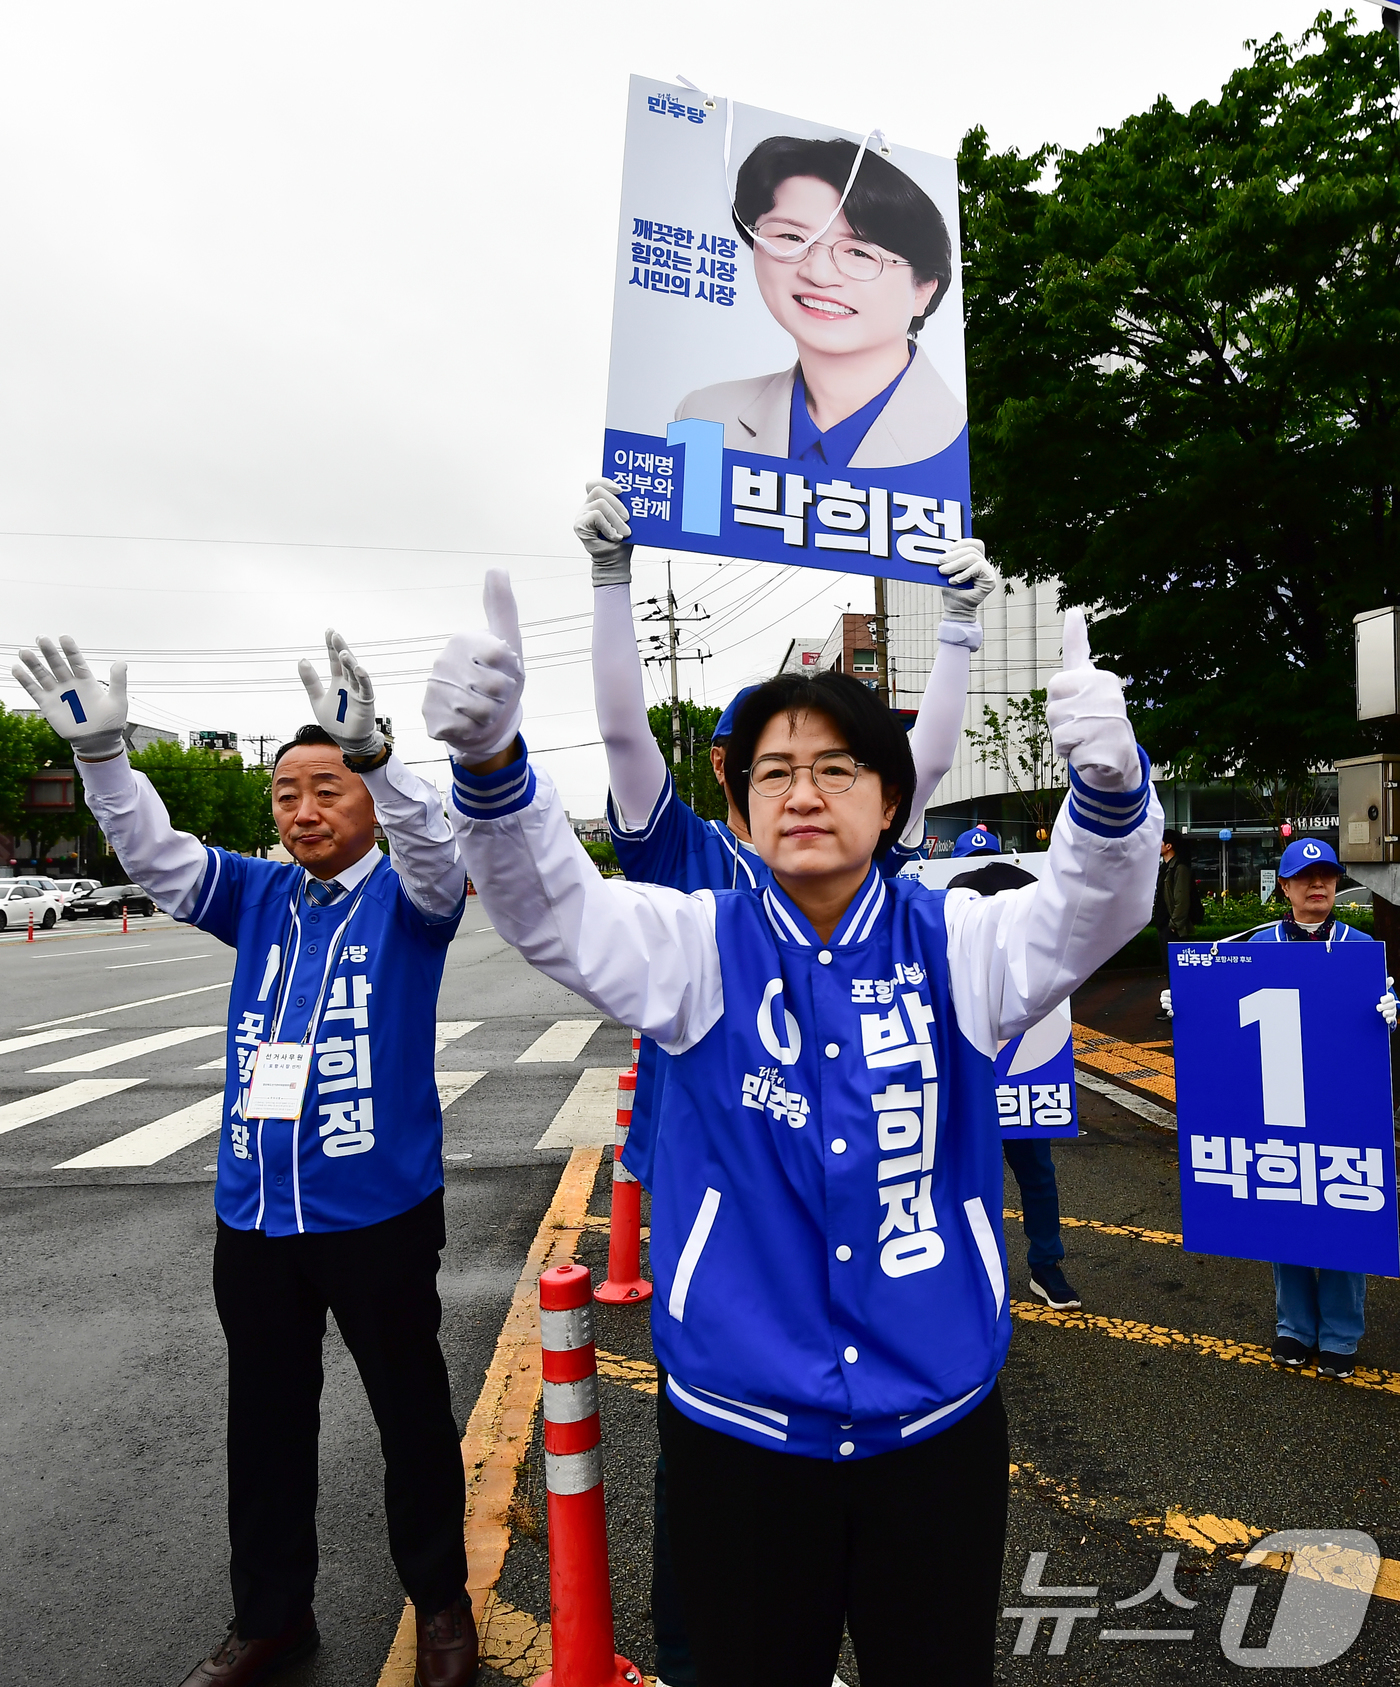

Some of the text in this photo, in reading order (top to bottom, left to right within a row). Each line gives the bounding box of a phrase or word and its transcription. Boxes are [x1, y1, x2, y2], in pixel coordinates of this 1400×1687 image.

[647, 96, 707, 124] 민주당
[632, 217, 738, 259] 깨끗한 시장
[631, 241, 737, 282] 힘있는 시장
[629, 266, 737, 307] 시민의 시장
[614, 449, 674, 476] 이재명
[666, 417, 724, 537] 1
[613, 471, 674, 499] 정부와
[630, 496, 671, 521] 함께
[731, 465, 962, 566] 박희정
[60, 689, 88, 725] 1
[336, 688, 348, 724] 1
[257, 944, 281, 1001] 1
[1176, 953, 1213, 967] 민주당
[265, 1053, 304, 1061] 선거사무원
[316, 974, 375, 1158] 박희정
[1238, 987, 1306, 1128] 1
[741, 1072, 811, 1129] 민주당
[860, 991, 946, 1279] 박희정
[1190, 1134, 1386, 1212] 박희정
